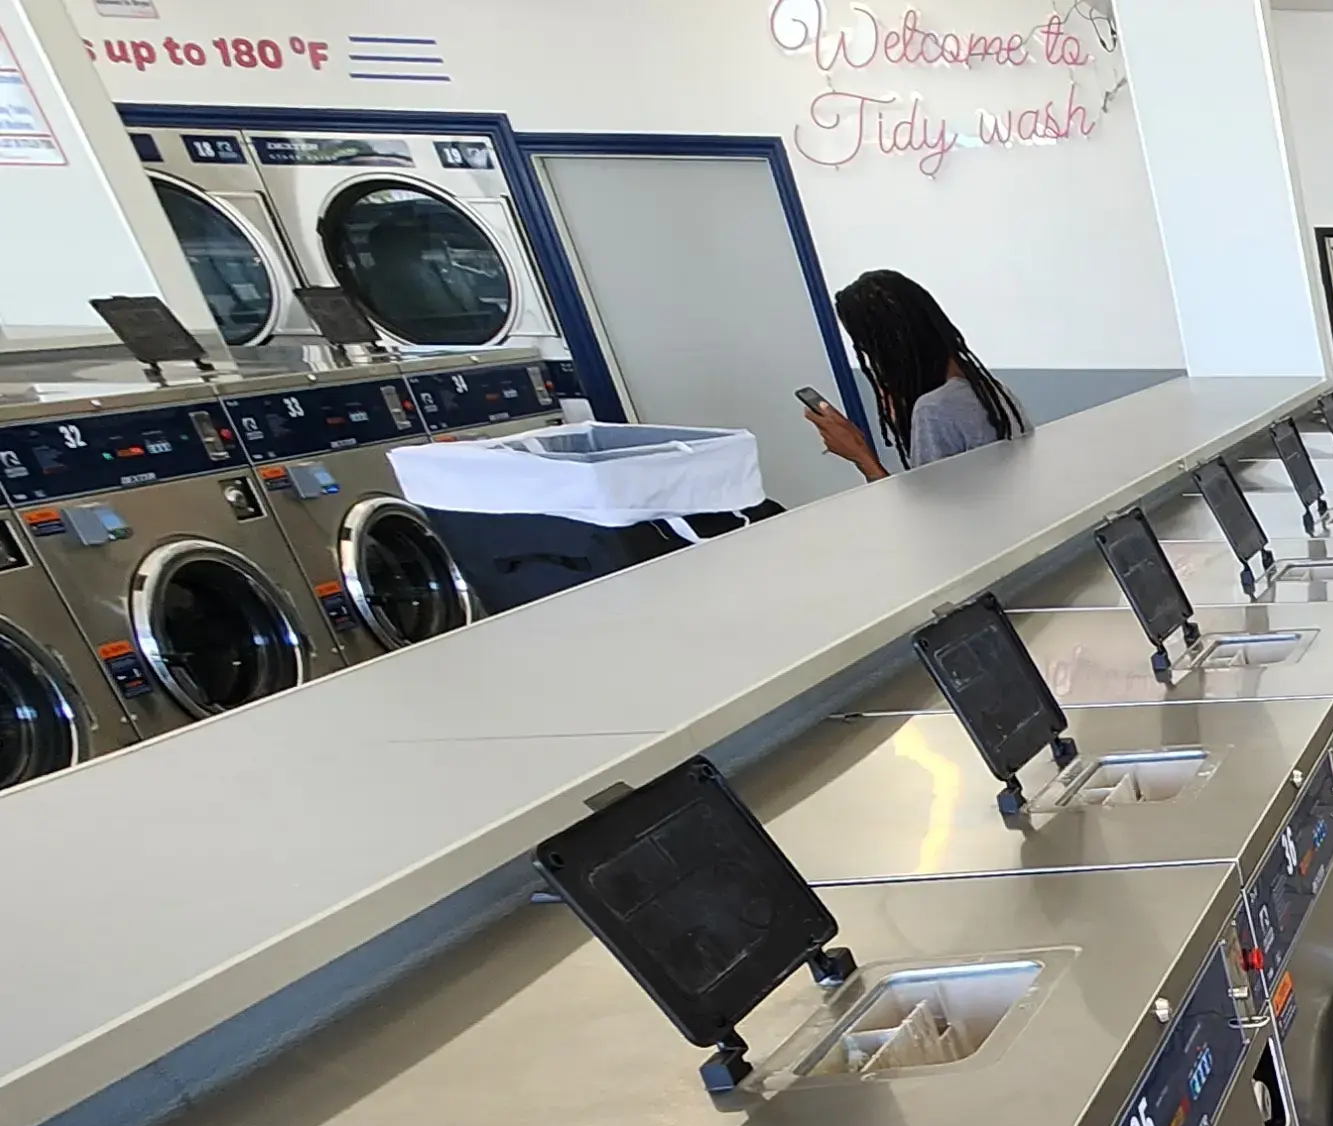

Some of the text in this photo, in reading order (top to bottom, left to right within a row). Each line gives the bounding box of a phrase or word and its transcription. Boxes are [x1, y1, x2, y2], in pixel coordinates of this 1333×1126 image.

[770, 0, 1090, 72] Welcome to
[104, 38, 157, 71] up
[163, 36, 207, 66] to
[212, 37, 283, 70] 180
[795, 84, 1095, 178] Tidy wash
[452, 374, 468, 393] 34
[283, 396, 304, 418] 33
[58, 424, 88, 449] 32
